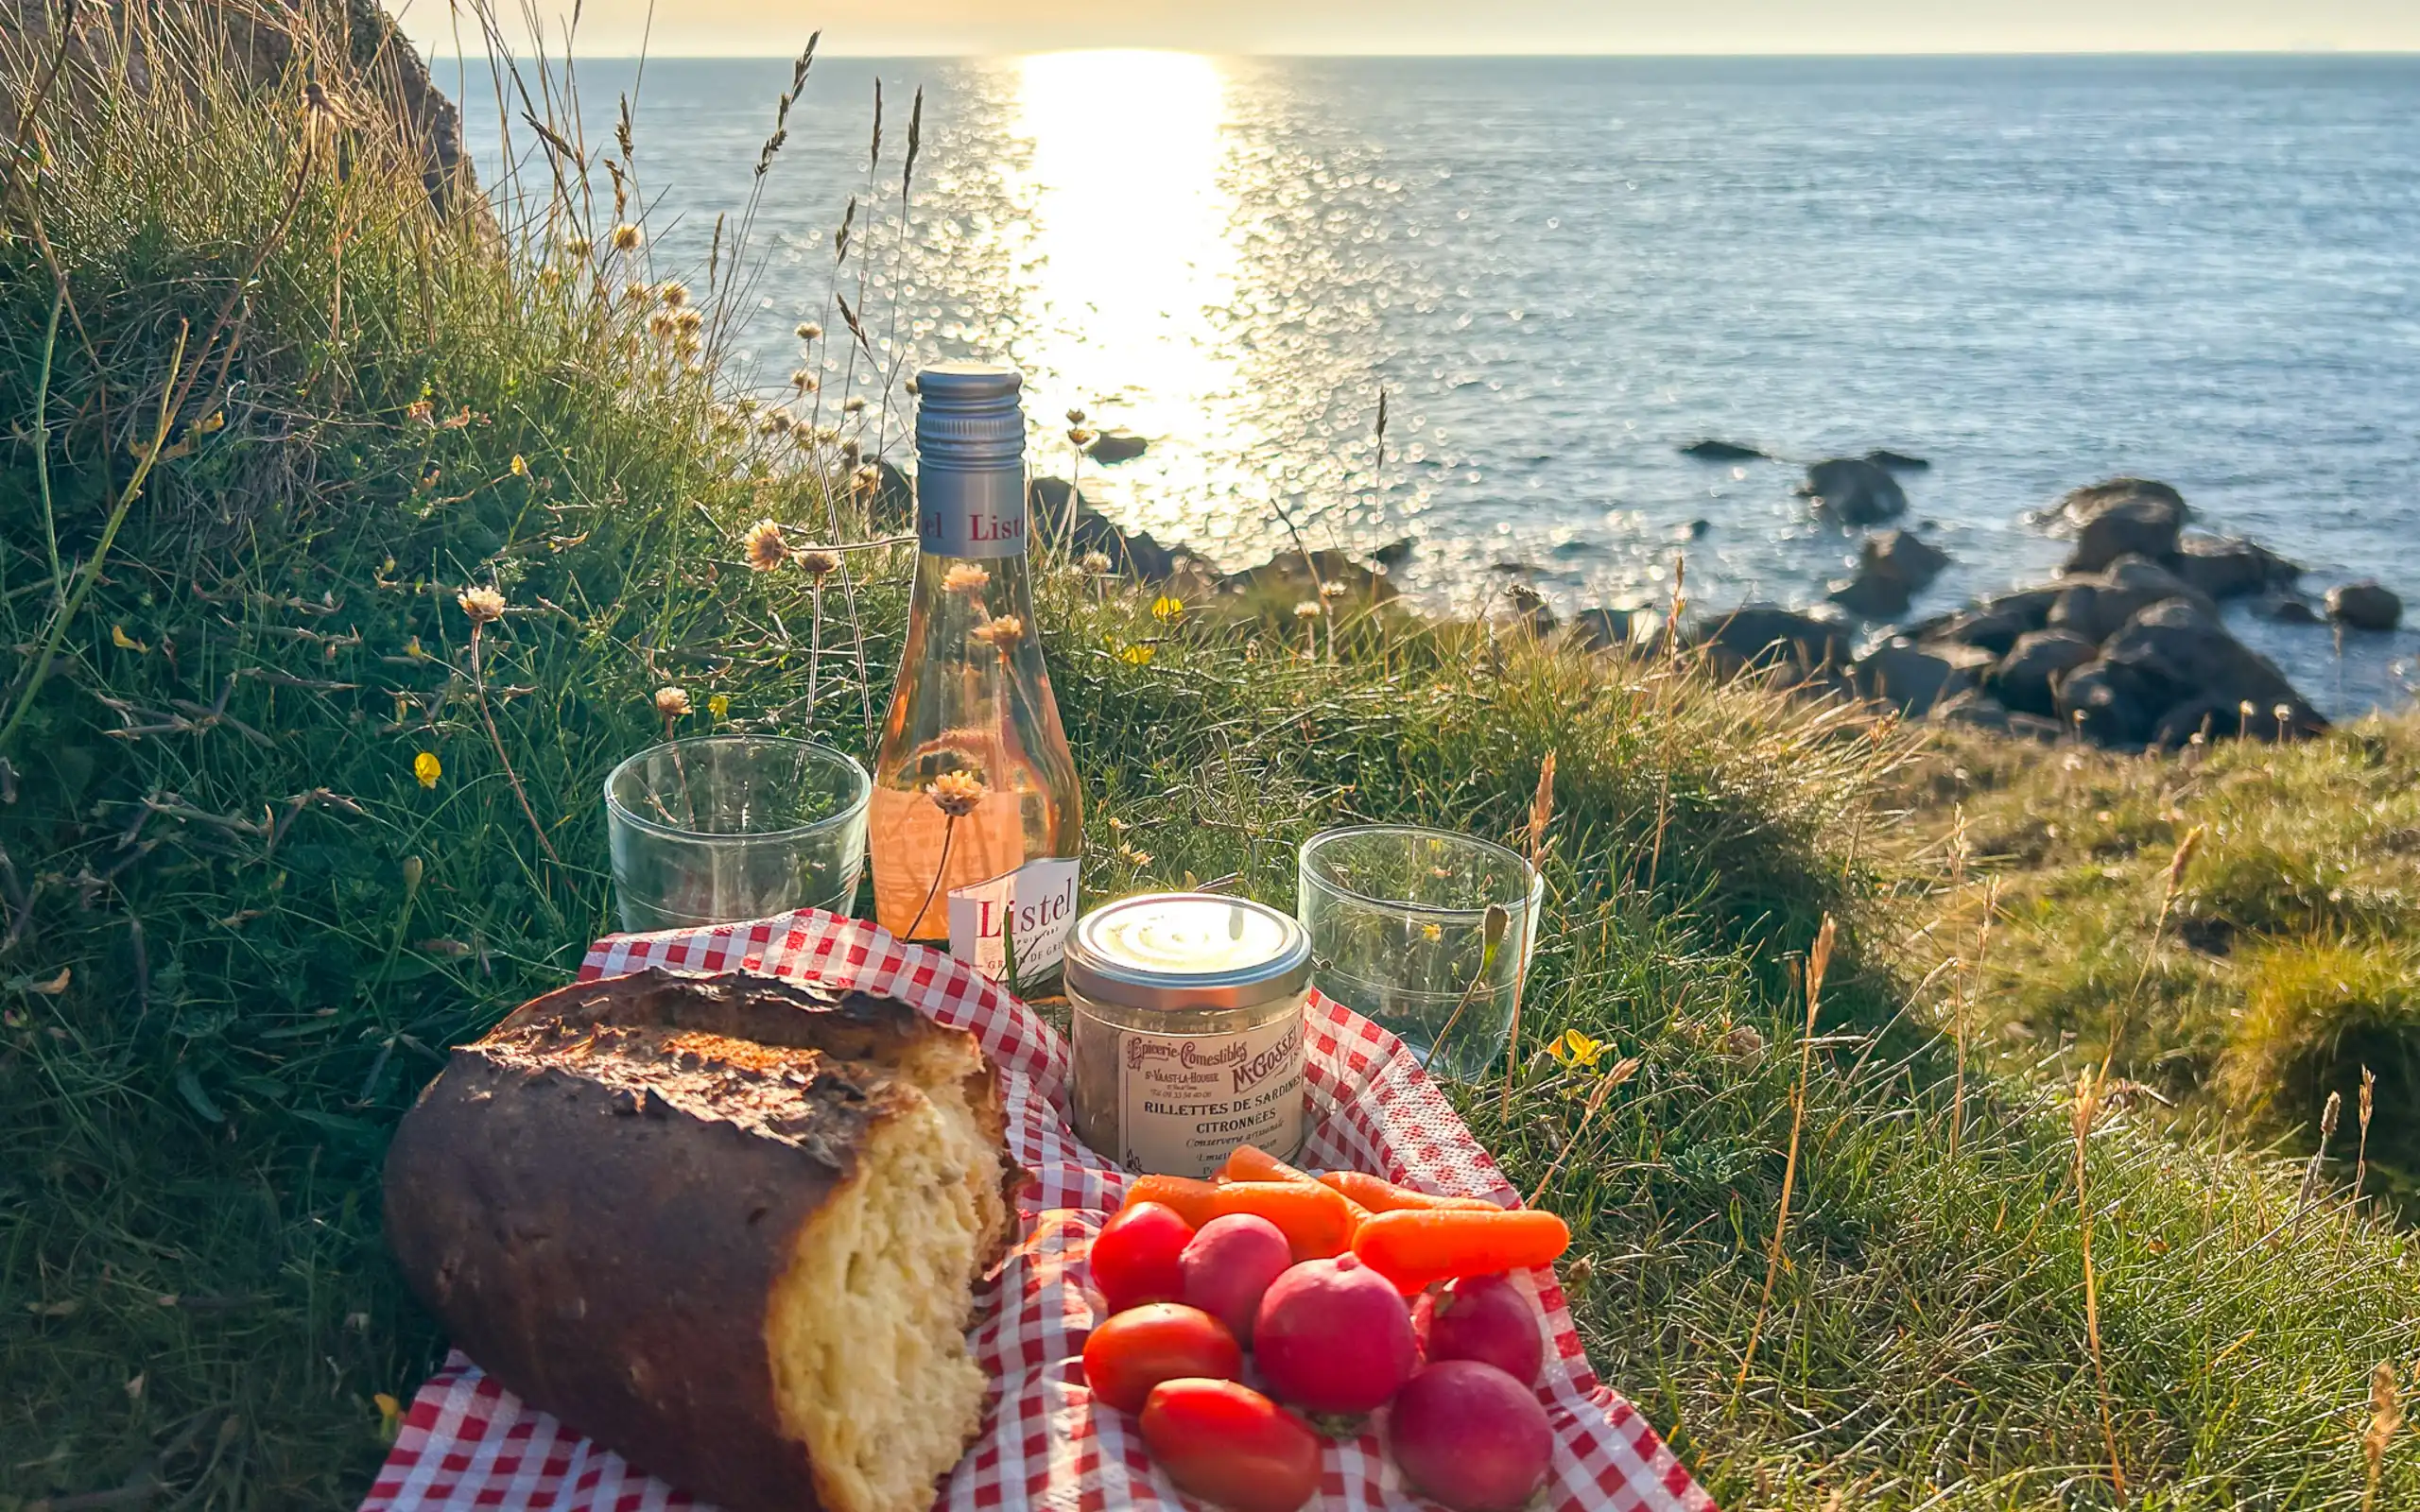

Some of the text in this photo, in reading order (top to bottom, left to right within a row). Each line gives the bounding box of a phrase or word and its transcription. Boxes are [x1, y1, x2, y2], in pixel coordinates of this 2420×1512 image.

[976, 877, 1072, 937] Listel
[1144, 1074, 1301, 1116] RILLETTES DE SARDINES
